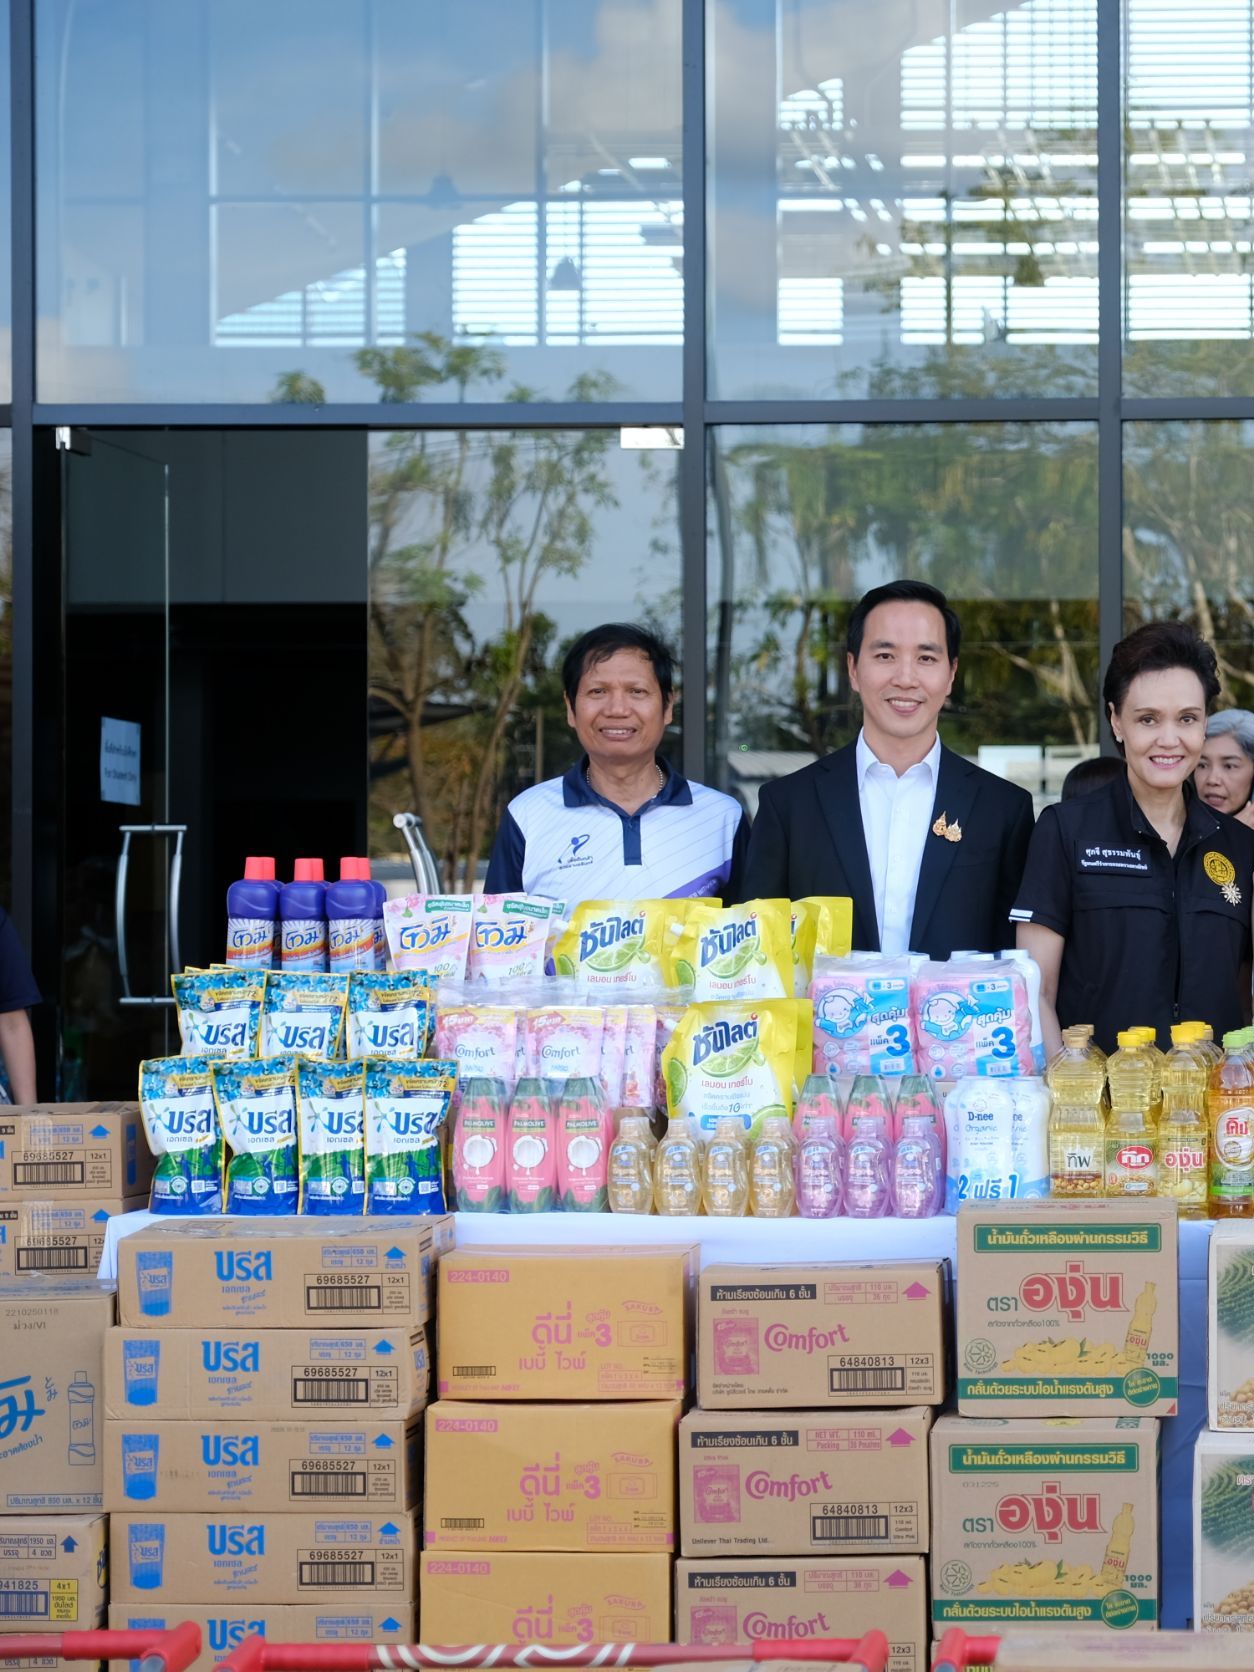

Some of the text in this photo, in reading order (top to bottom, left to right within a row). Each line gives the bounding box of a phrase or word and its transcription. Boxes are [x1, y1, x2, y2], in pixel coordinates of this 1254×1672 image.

[400, 917, 451, 949] โทมิ
[476, 920, 527, 948] โทมิ
[580, 910, 646, 962] ซันไลต์
[700, 912, 758, 968] ซันไลต์
[206, 1022, 247, 1046] บรีส
[283, 1024, 326, 1049] บรีส
[372, 1022, 414, 1047] บรีส
[693, 1013, 758, 1066] ซันไลต์
[886, 1024, 910, 1057] 3
[991, 1026, 1016, 1059] 3
[455, 1044, 495, 1057] Comfort
[168, 1108, 211, 1134] บรีส
[247, 1108, 292, 1134] บรีส
[968, 1112, 994, 1122] D-nee
[1067, 1152, 1091, 1168] ทิพ
[1165, 1147, 1204, 1171] องุ่น
[958, 1174, 1019, 1199] 2 ฟรี 1
[988, 1228, 1148, 1246] น้ำมันถั่วเหลืองผ่านกรรมวิธี
[214, 1250, 272, 1281] บรีส
[316, 1275, 370, 1284] 69685527
[387, 1276, 404, 1284] 12x1
[451, 1272, 507, 1282] 224-0140
[716, 1286, 811, 1300] ห้ามเรียงซ้อนเกิน 6 ชั้น
[986, 1262, 1128, 1322] ตรา องุ่น
[532, 1301, 572, 1345] ดีนี่
[764, 1323, 849, 1354] Comfort
[519, 1347, 587, 1370] เบบี้ ไวพ์
[840, 1357, 895, 1367] 64840813
[910, 1357, 929, 1365] 12x3
[304, 1368, 358, 1377] 69685527
[438, 1421, 496, 1432] 224-0140
[852, 1430, 864, 1438] 110
[697, 1432, 793, 1446] ห้ามเรียงซ้อนเกิน 6 ชั้น
[816, 1441, 840, 1450] Packing
[302, 1461, 356, 1470] 69685527
[962, 1449, 1126, 1465] น้ำมันถั่วเหลืองผ่านกรรมวิธี
[519, 1452, 561, 1497] ดีนี่
[745, 1470, 833, 1501] Comfort
[506, 1500, 576, 1522] เบบี้ ไวพ์
[822, 1505, 878, 1515] 64840813
[894, 1505, 914, 1513] 12x3
[962, 1481, 1106, 1544] ตรา องุ่น
[734, 1537, 756, 1545] Trading
[309, 1551, 363, 1560] 69685527
[381, 1552, 398, 1560] 12x1
[430, 1563, 488, 1574] 224-0140
[57, 1582, 70, 1590] 4x1
[694, 1574, 790, 1588] ห้ามเรียงซ้อนเกิน 6 ชั้น
[1125, 1574, 1152, 1582] 1000
[512, 1594, 554, 1639] ดีนี่
[743, 1611, 830, 1639] Comfort
[892, 1646, 911, 1654] 12x3
